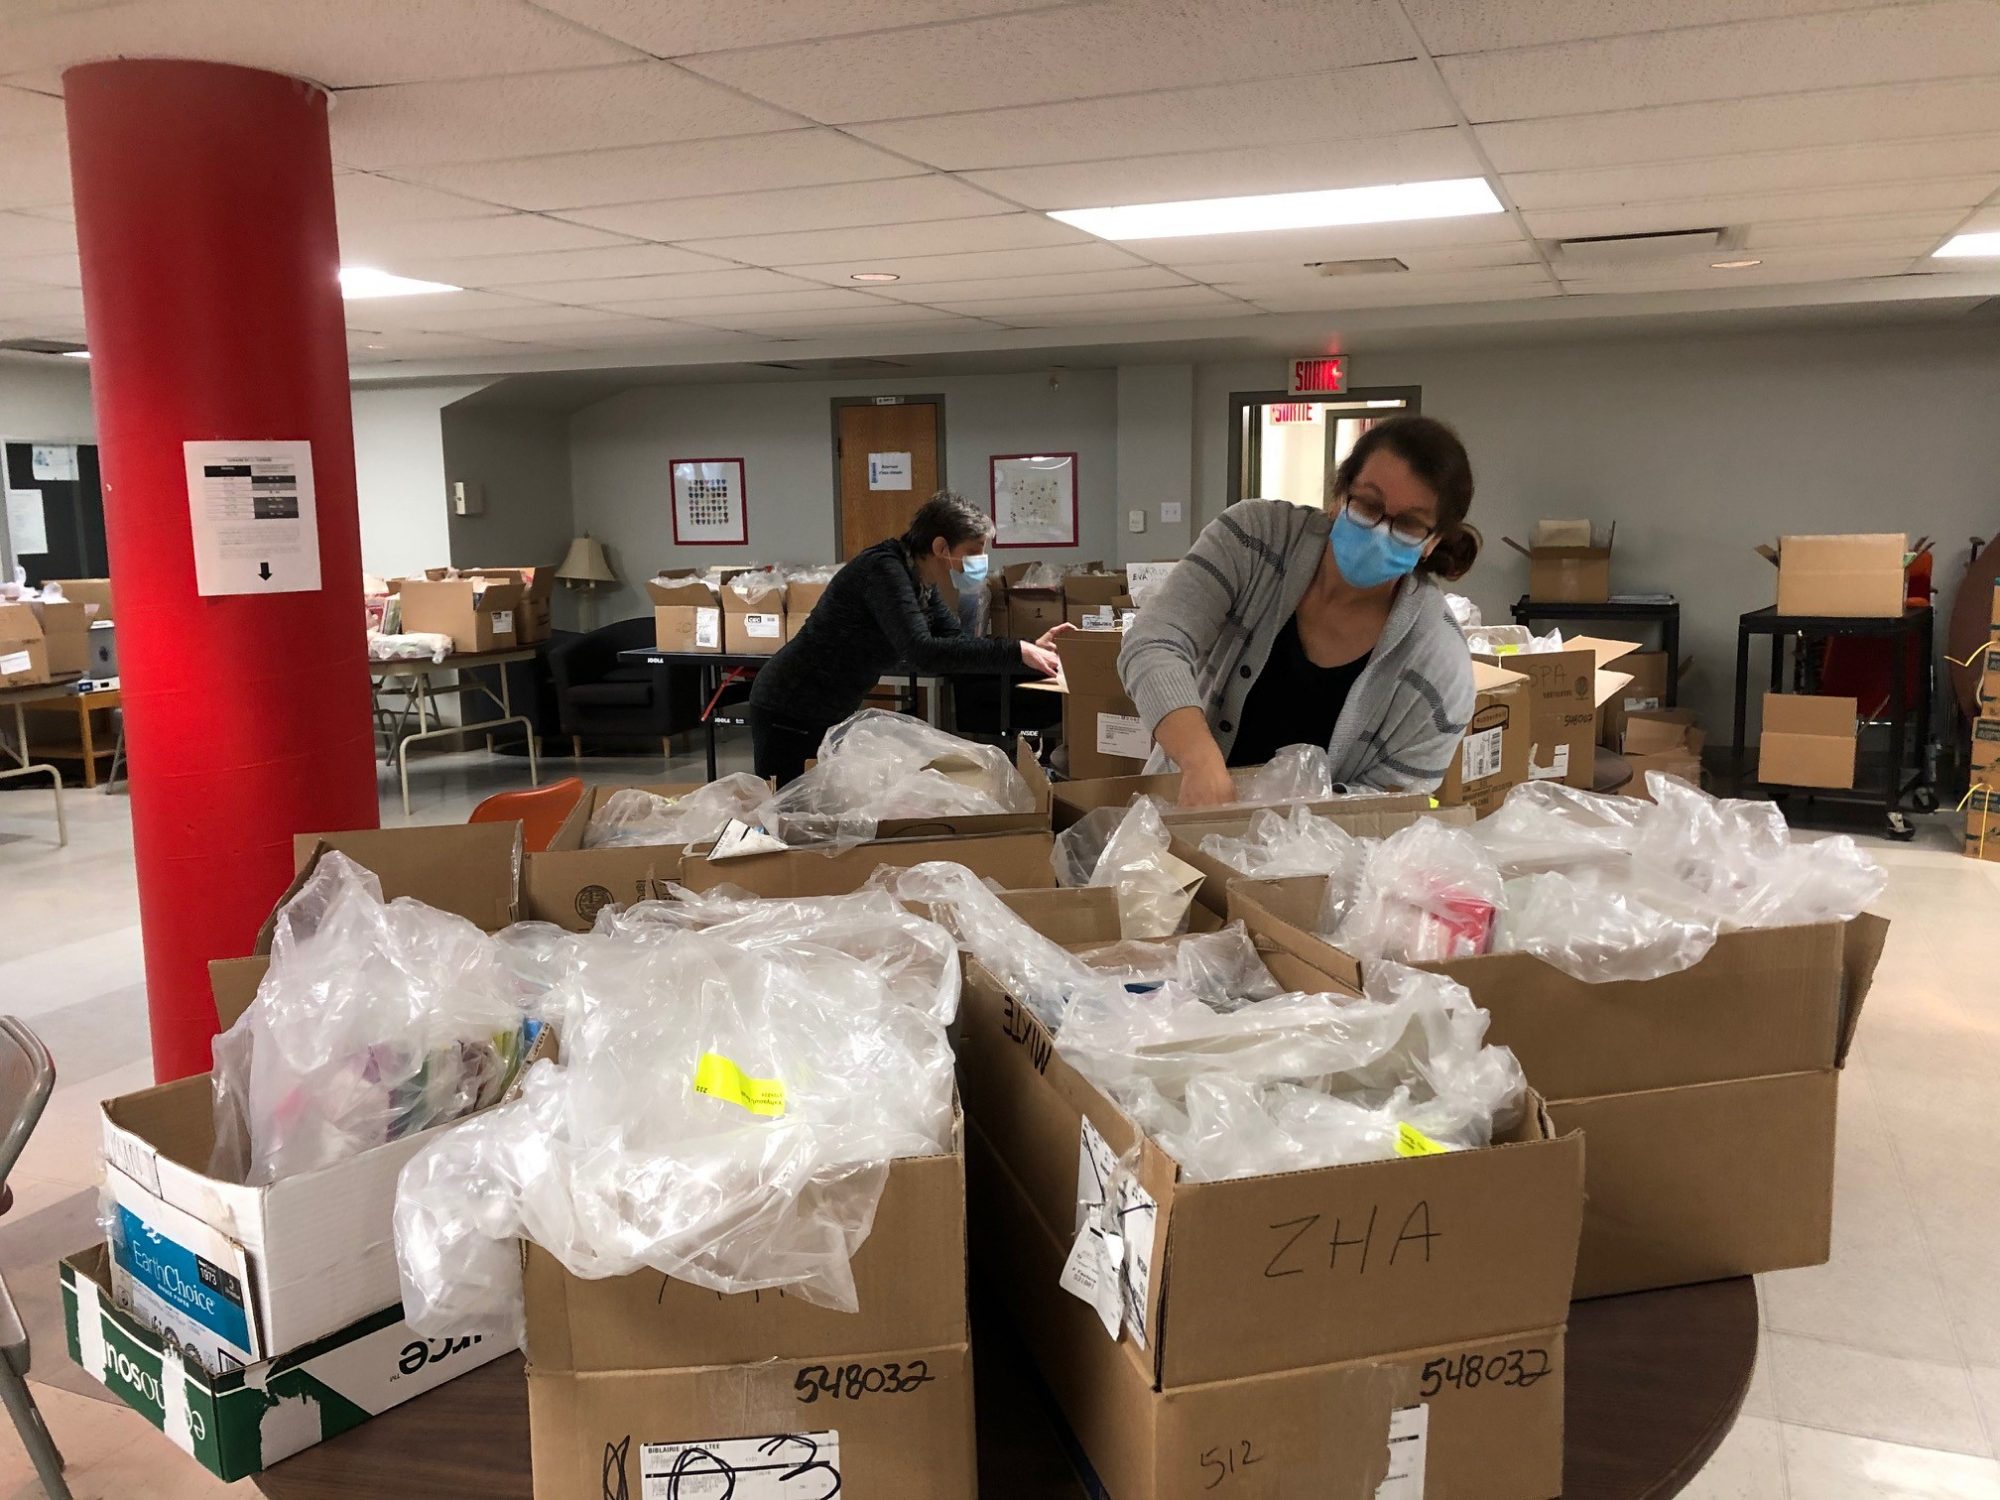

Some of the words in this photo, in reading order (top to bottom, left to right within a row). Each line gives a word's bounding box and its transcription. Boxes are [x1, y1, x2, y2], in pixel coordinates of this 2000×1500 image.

[1295, 359, 1341, 391] SORTIE
[1263, 1199, 1443, 1279] ZHA
[132, 1239, 216, 1316] EarthChoice
[794, 1360, 936, 1403] 548032
[1419, 1349, 1554, 1398] 548032
